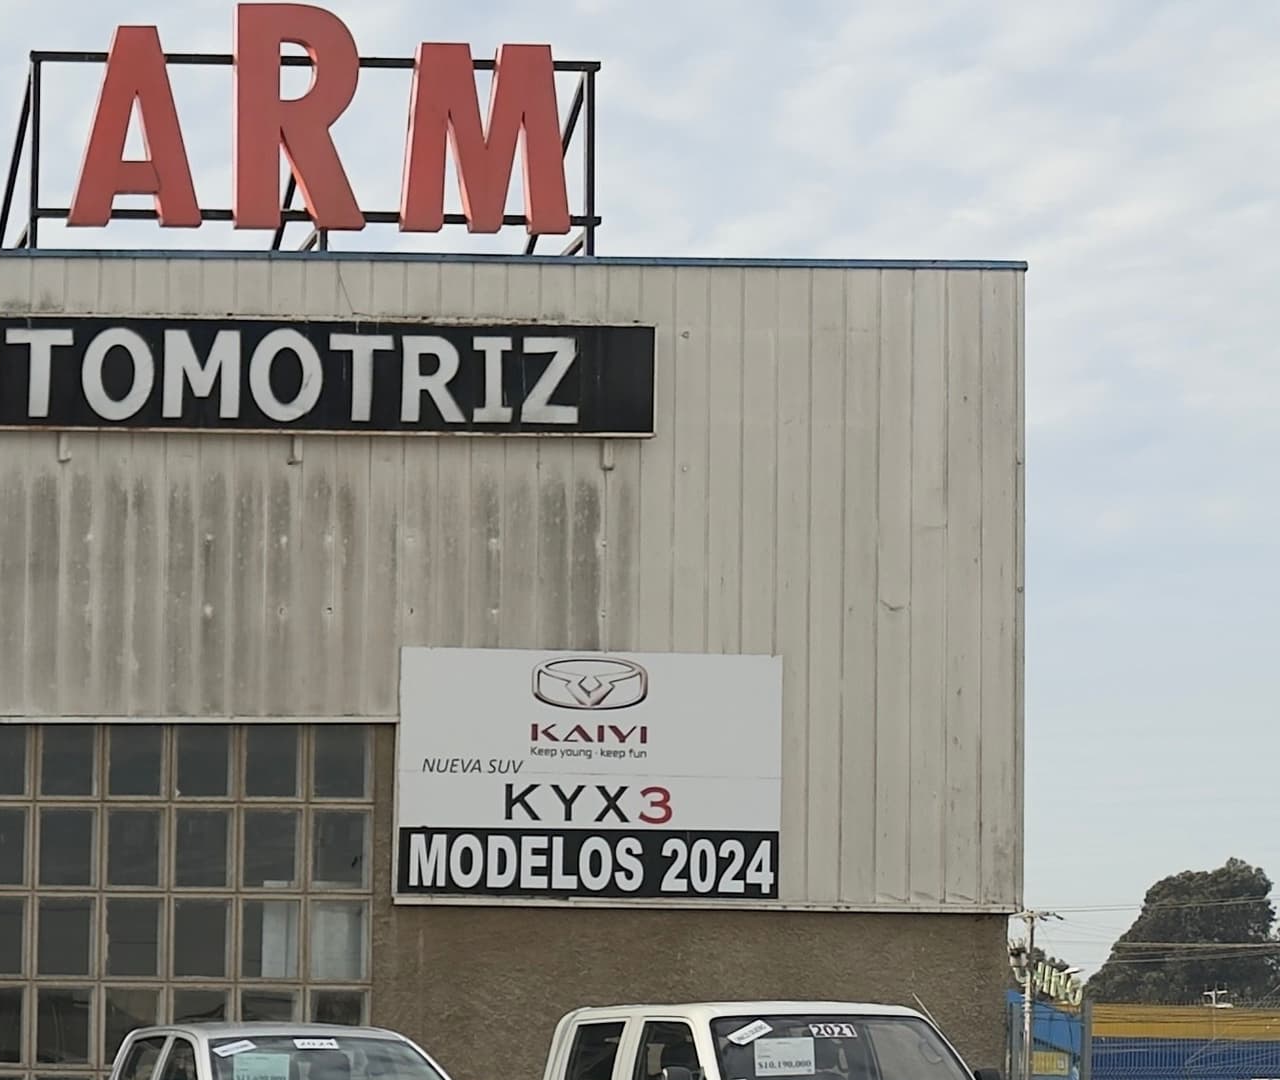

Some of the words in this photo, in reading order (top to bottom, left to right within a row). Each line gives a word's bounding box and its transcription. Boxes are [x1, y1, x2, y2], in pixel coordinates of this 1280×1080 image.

[66, 2, 572, 235] ARM
[531, 723, 648, 744] KAIYI
[530, 747, 558, 758] Keep
[560, 748, 593, 760] young
[600, 749, 626, 759] keep
[629, 749, 648, 759] fun
[422, 758, 483, 774] NUEVA
[487, 759, 524, 774] SUV
[504, 783, 673, 825] KYX3
[408, 832, 645, 892] MODELOS
[660, 838, 775, 895] 2024
[811, 1023, 856, 1037] 2021
